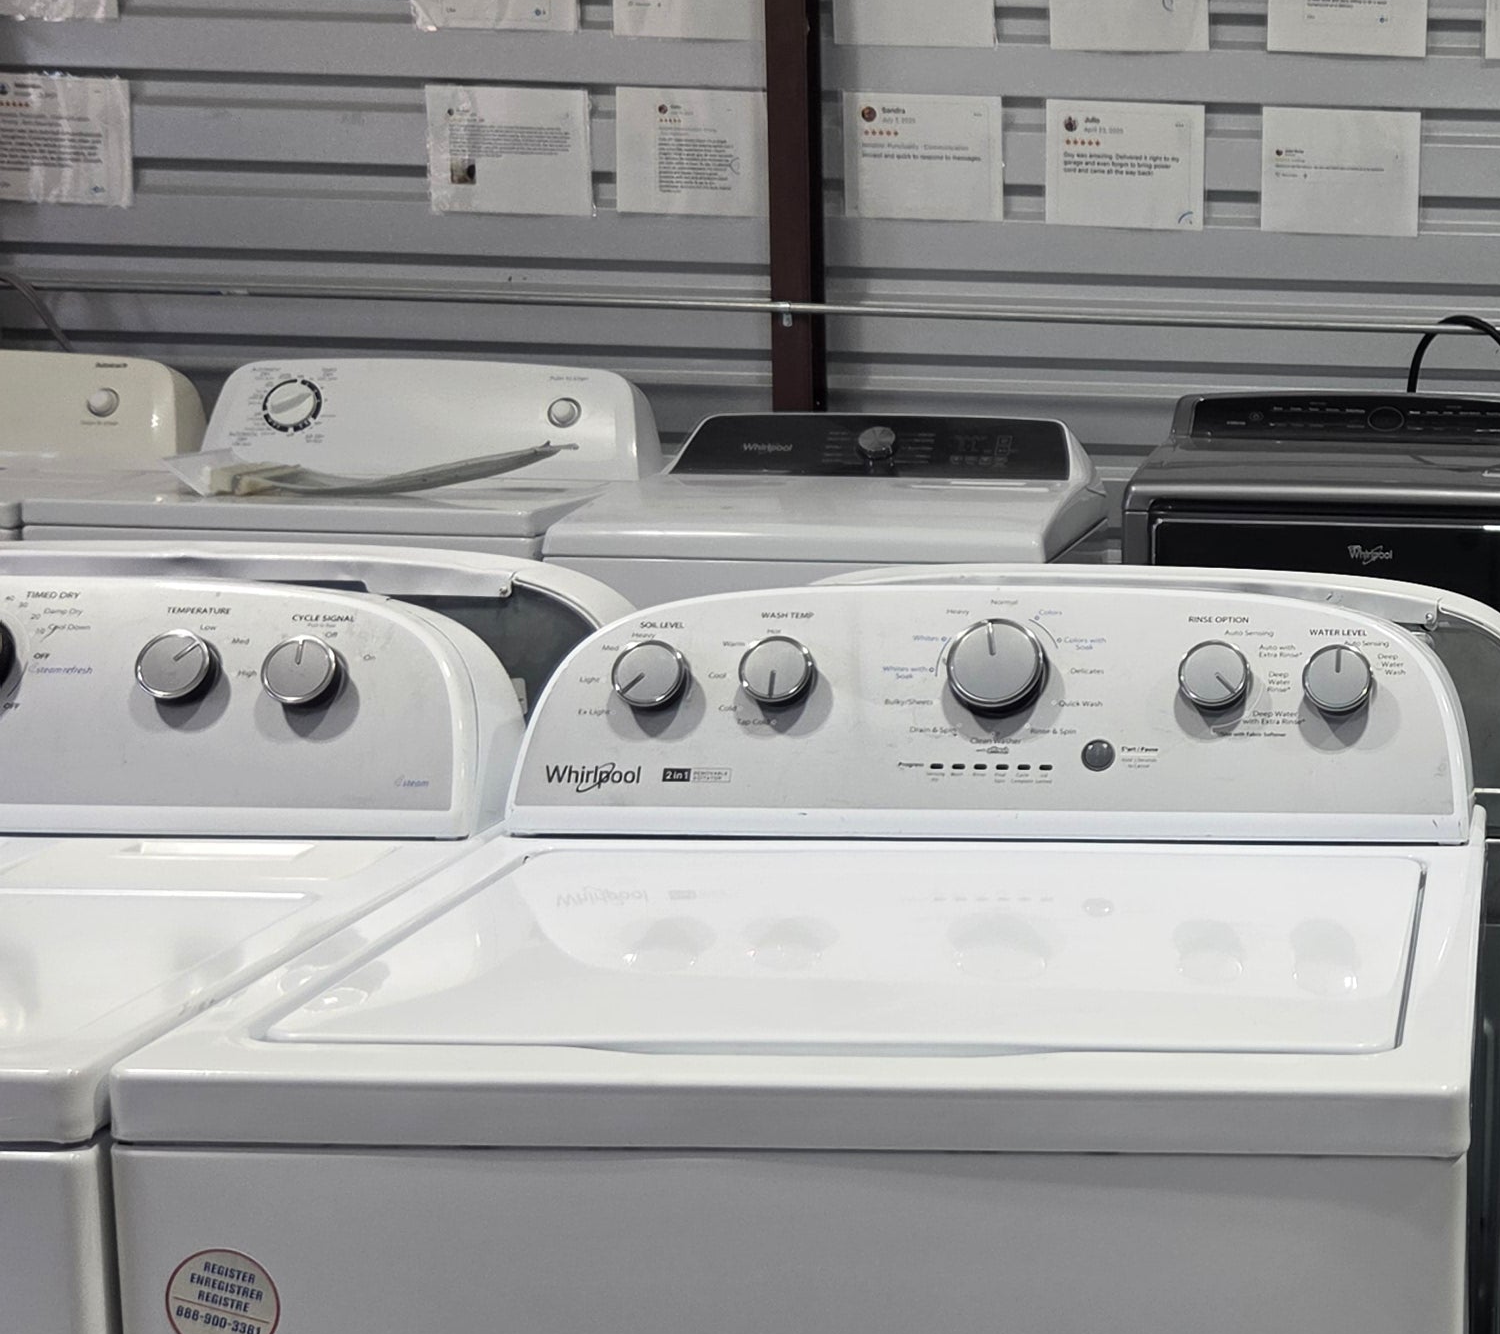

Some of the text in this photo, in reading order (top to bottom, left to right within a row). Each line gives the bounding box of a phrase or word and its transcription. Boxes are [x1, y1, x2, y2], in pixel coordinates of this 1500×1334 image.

[167, 606, 231, 615] TEMPERATURE
[761, 611, 814, 619] WASH TEMP
[292, 614, 355, 623] CYCLE SIGNAL
[1215, 616, 1249, 624] OPTION
[640, 621, 658, 629] SOIL
[1343, 629, 1367, 637] LEVEL
[545, 763, 641, 792] Whirlpool
[203, 1261, 256, 1285] REGISTER
[189, 1272, 264, 1302] ENREGISTRER
[197, 1289, 251, 1313] REGISTRE
